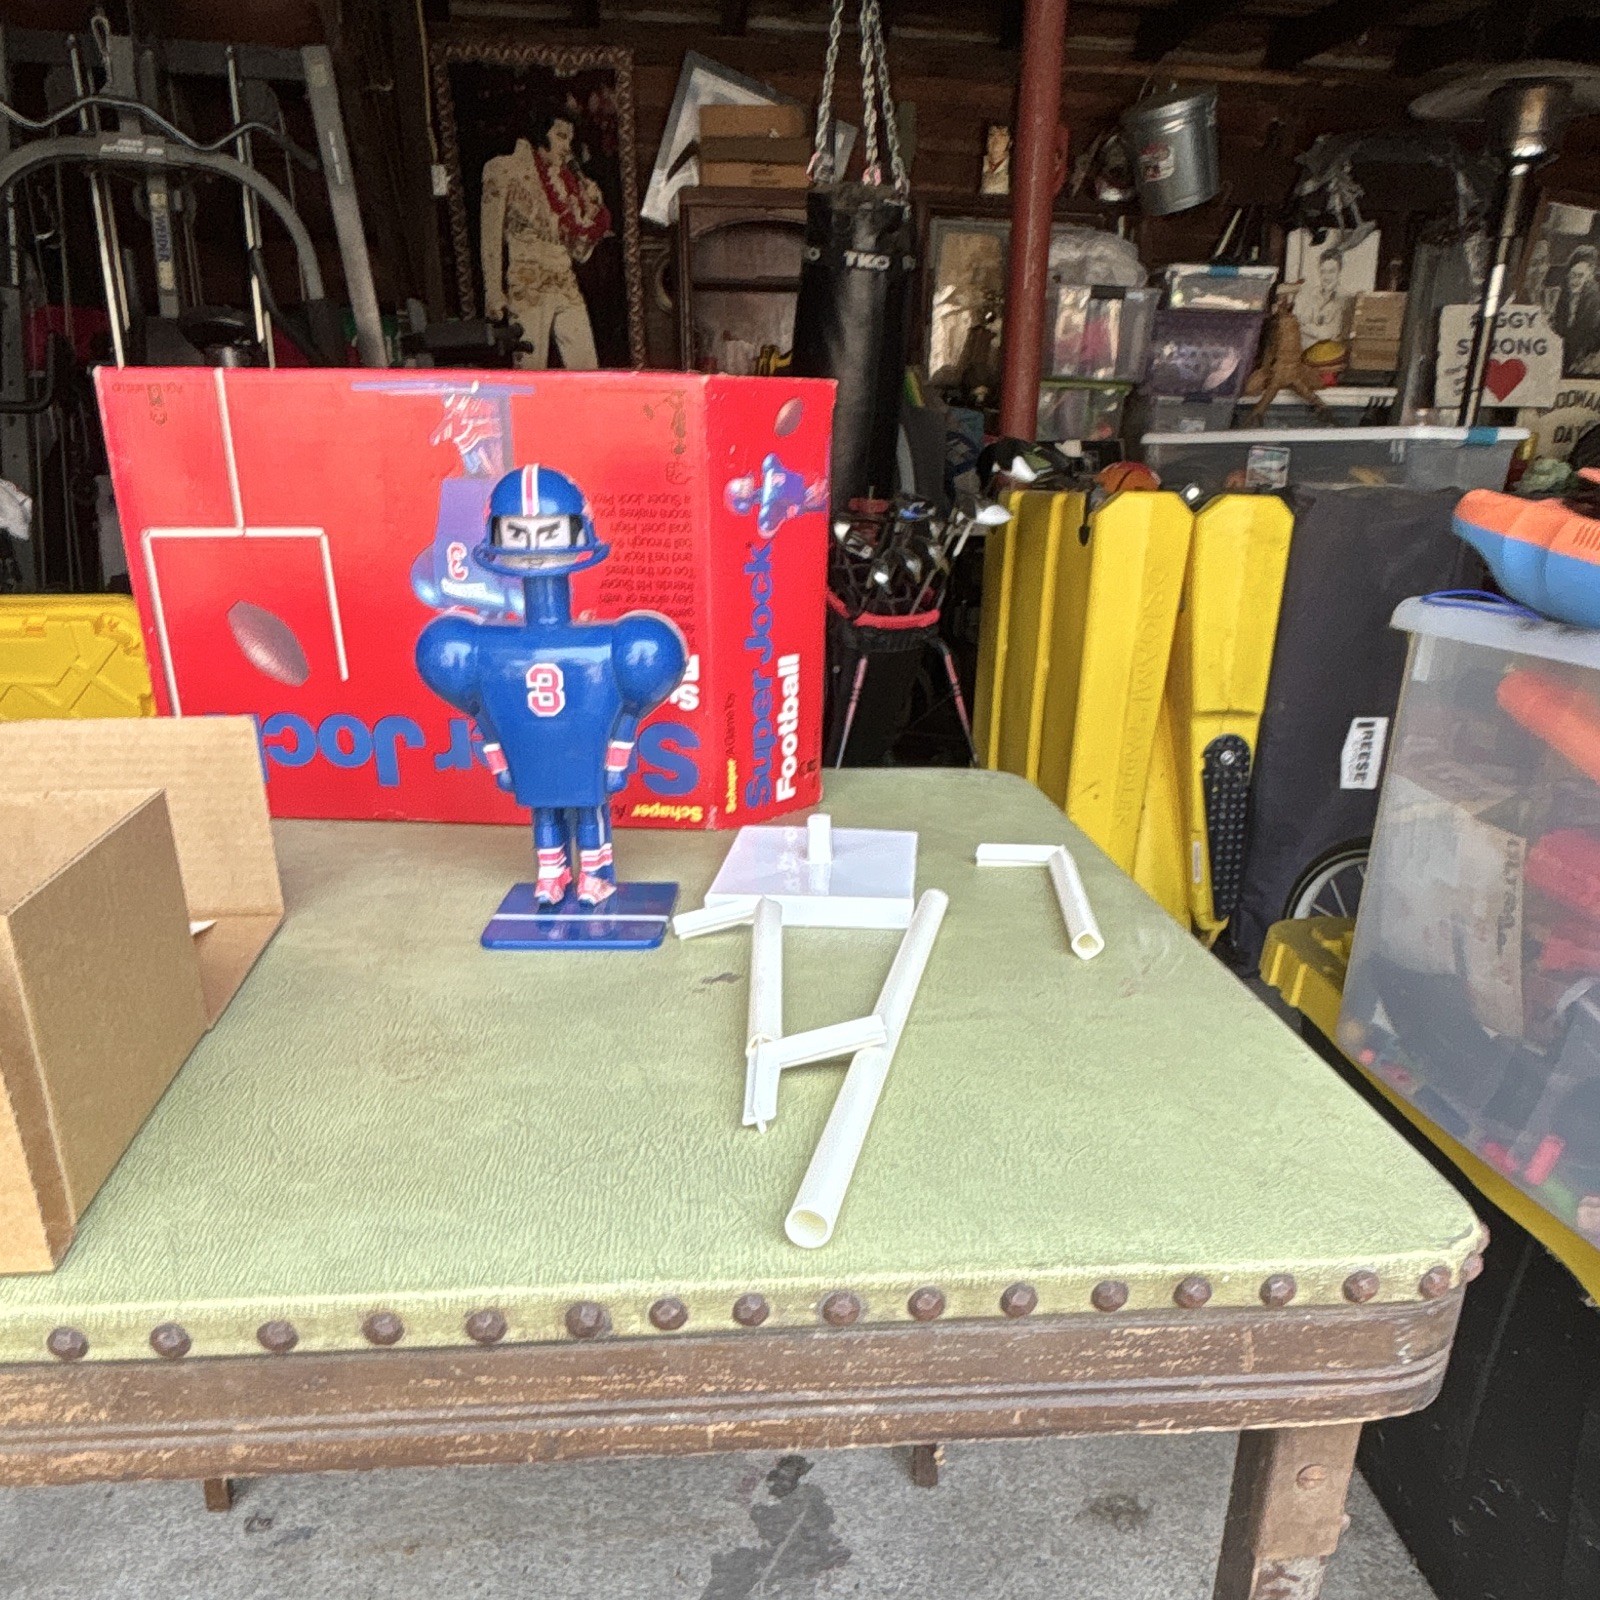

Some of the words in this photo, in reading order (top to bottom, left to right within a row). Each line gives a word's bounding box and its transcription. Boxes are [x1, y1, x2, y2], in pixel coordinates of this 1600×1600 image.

[844, 249, 891, 271] TKO
[744, 540, 773, 664] Jock
[525, 663, 566, 717] 3
[255, 712, 426, 787] Joc
[745, 668, 778, 808] Super
[776, 653, 800, 802] Football
[1354, 729, 1376, 784] REESE
[631, 803, 704, 823] Schaper
